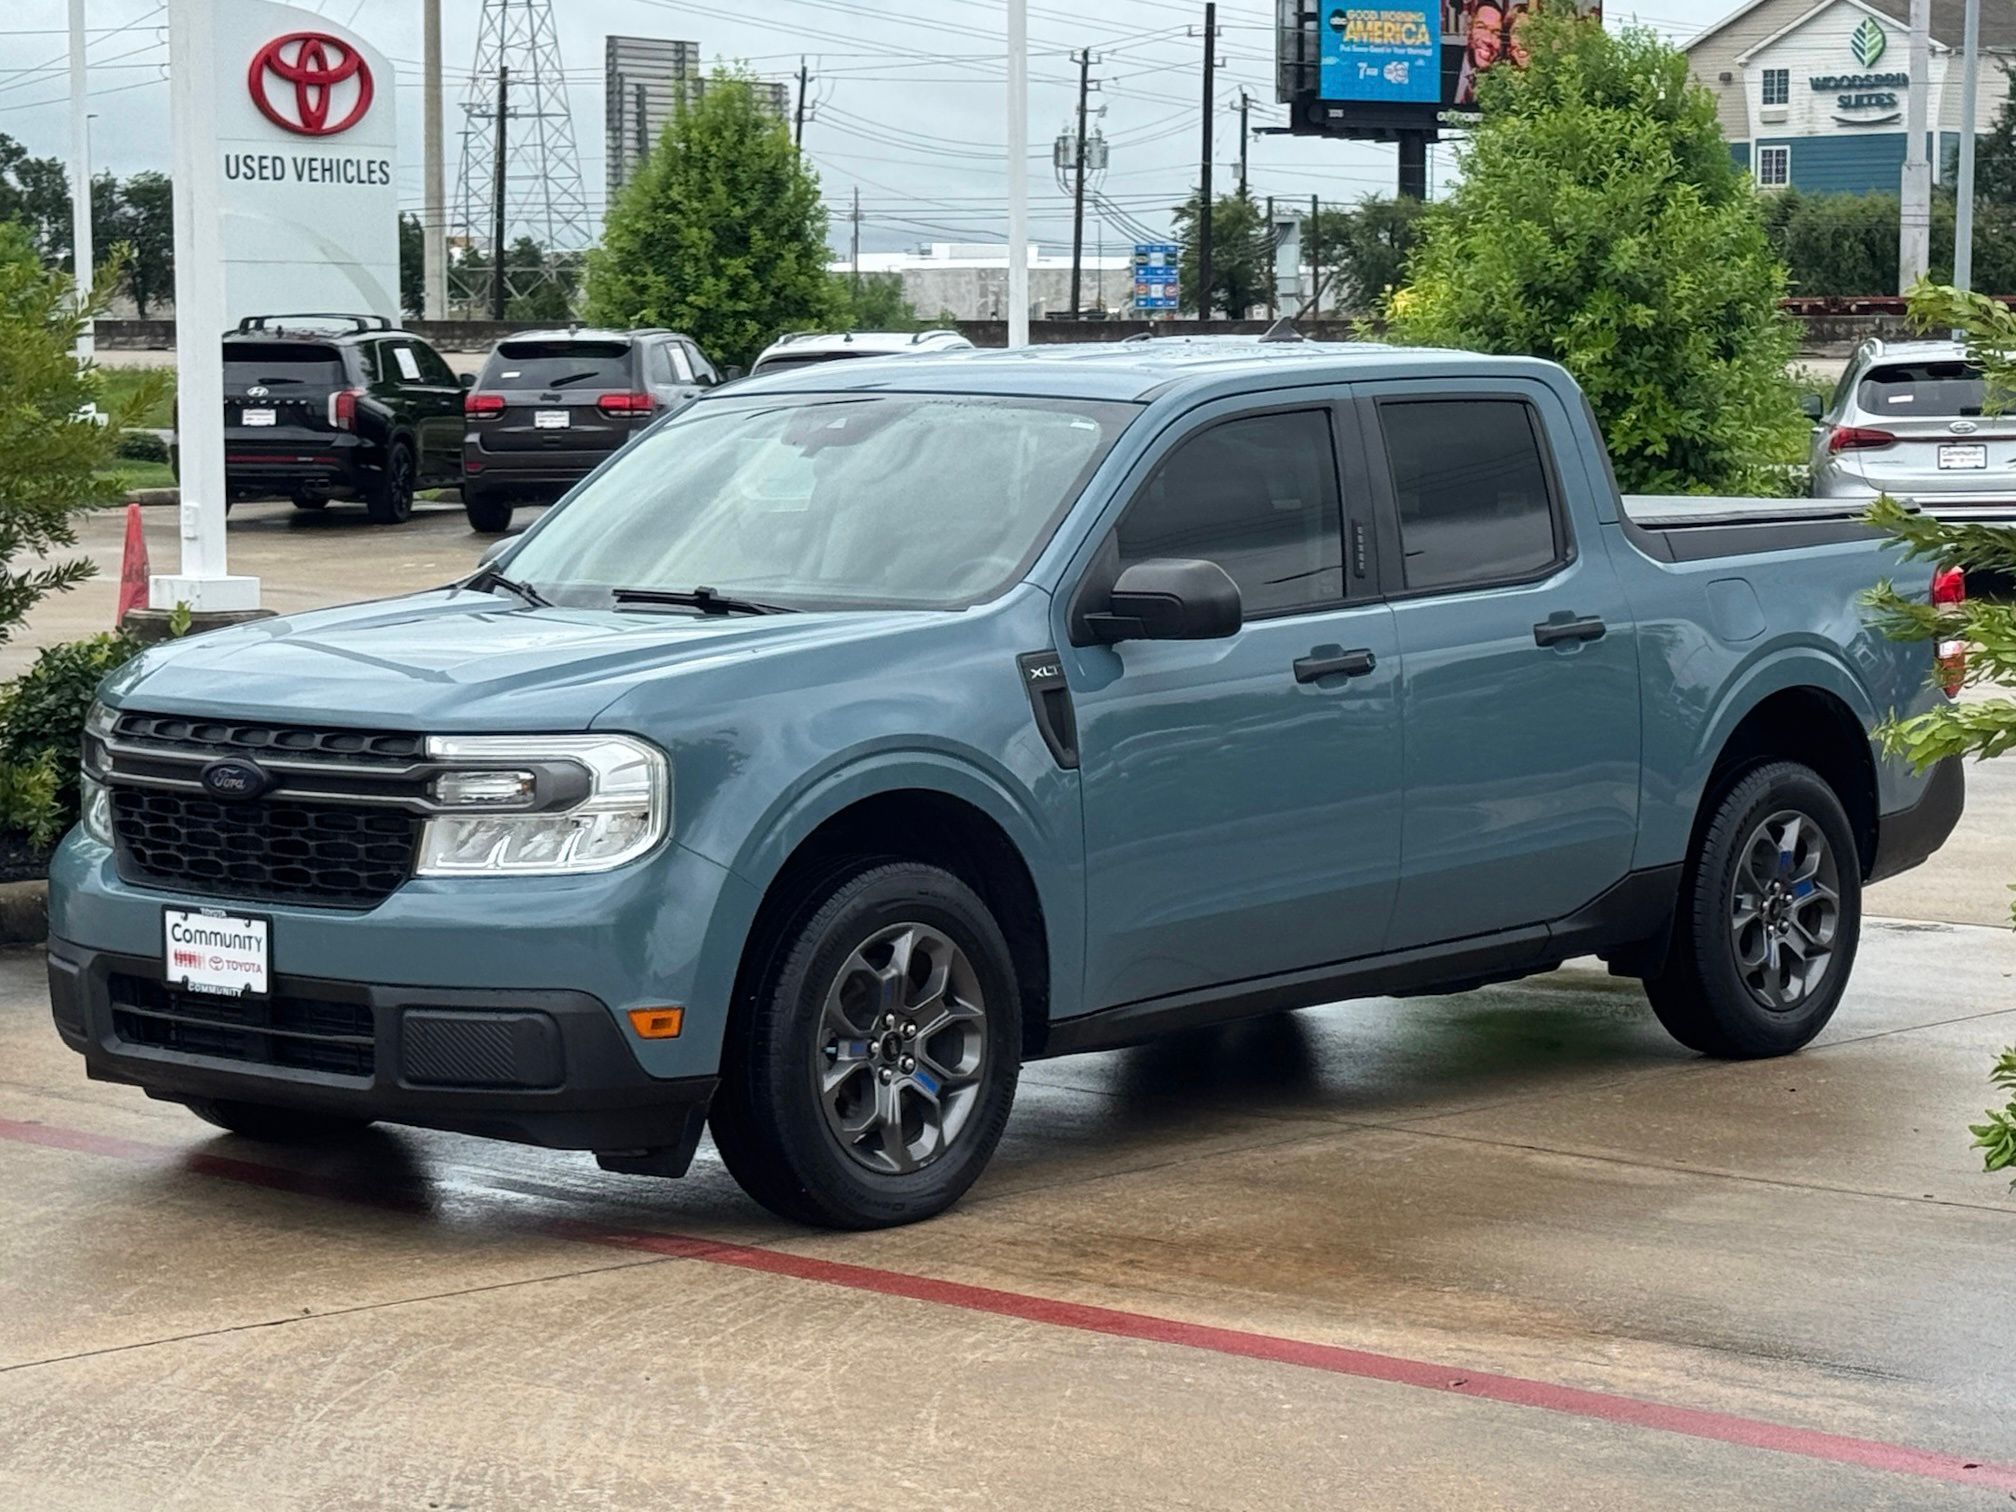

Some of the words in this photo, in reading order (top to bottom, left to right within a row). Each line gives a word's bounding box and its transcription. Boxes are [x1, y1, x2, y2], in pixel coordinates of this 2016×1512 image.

[1343, 20, 1431, 46] AMERICA
[225, 154, 286, 181] USED
[292, 157, 390, 185] VEHICLES
[213, 767, 248, 790] Ford
[226, 959, 262, 974] TOYOTA
[188, 982, 242, 998] COMMUNITY
